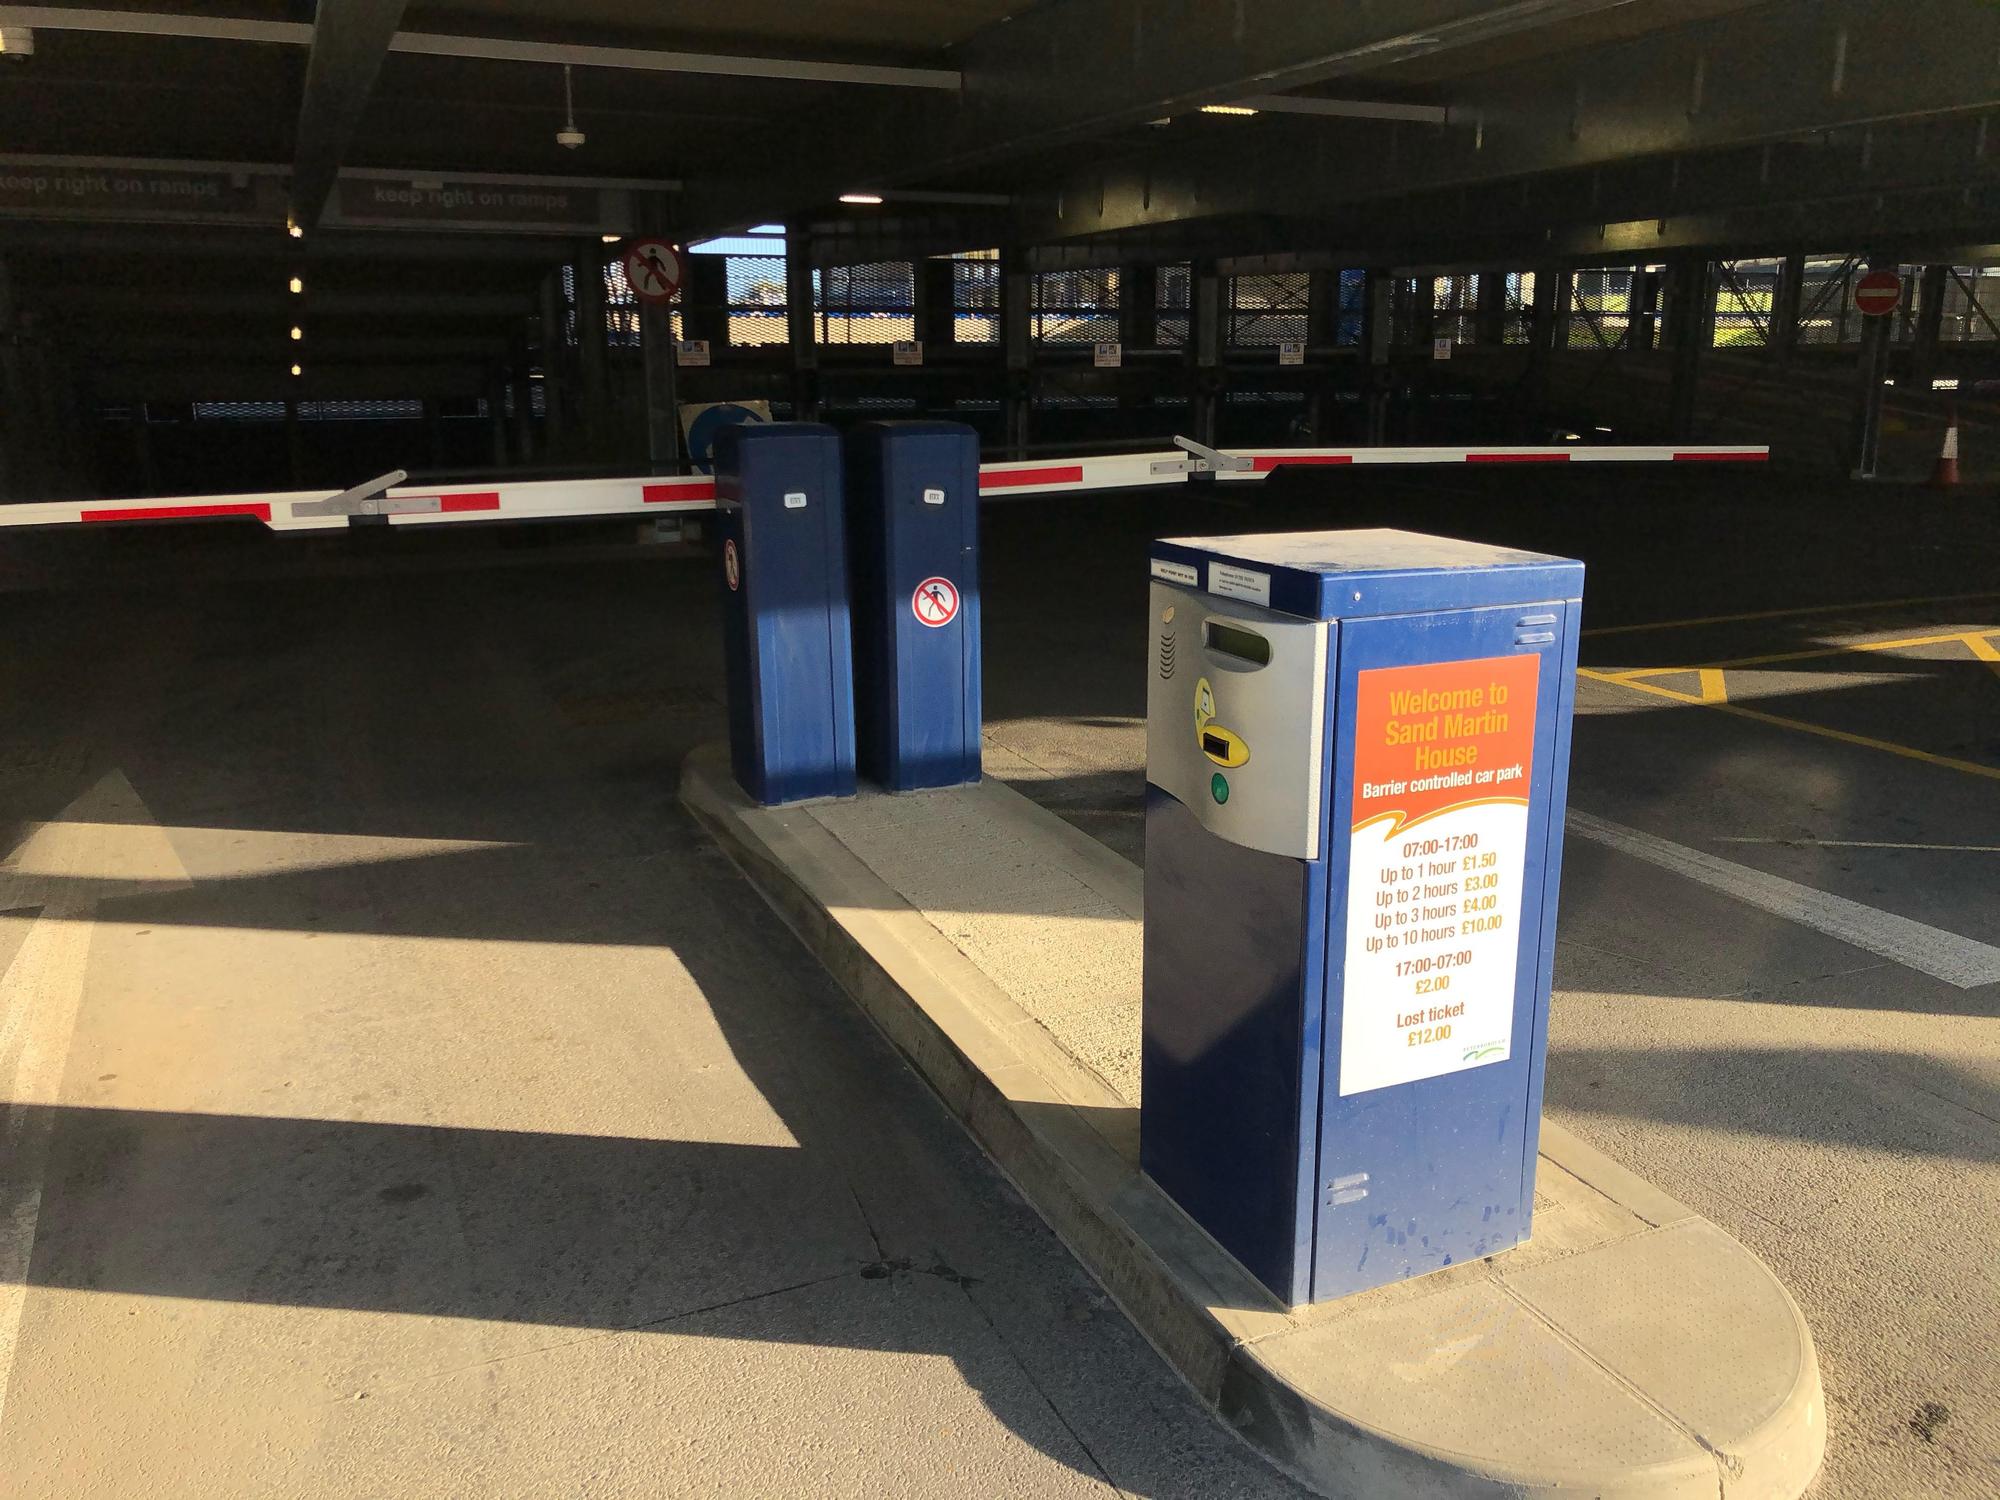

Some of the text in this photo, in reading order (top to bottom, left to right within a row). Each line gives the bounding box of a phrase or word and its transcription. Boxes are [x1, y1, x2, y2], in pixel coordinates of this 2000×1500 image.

[54, 175, 109, 196] right
[114, 179, 144, 193] on
[150, 180, 218, 199] ramps
[374, 186, 567, 211] keep right on ramps
[1389, 682, 1508, 716] Welcome to
[1385, 709, 1509, 746] Sand Martin
[1415, 745, 1478, 771] House
[1362, 763, 1523, 799] Barrier controlled car park
[1403, 833, 1479, 858] 07:00-17:00
[1381, 852, 1497, 885] Up to 1 hour £1.50
[1376, 873, 1498, 908] Up to 2 hours £3.00
[1375, 895, 1497, 930] Up to 3 hours £4.00
[1366, 914, 1503, 953] Up to 10 hours £10.00
[1395, 950, 1472, 977] 17:00-07:00
[1415, 975, 1450, 994] £2.00
[1396, 1001, 1465, 1028] Lost ticket
[1407, 1024, 1452, 1047] £12.00
